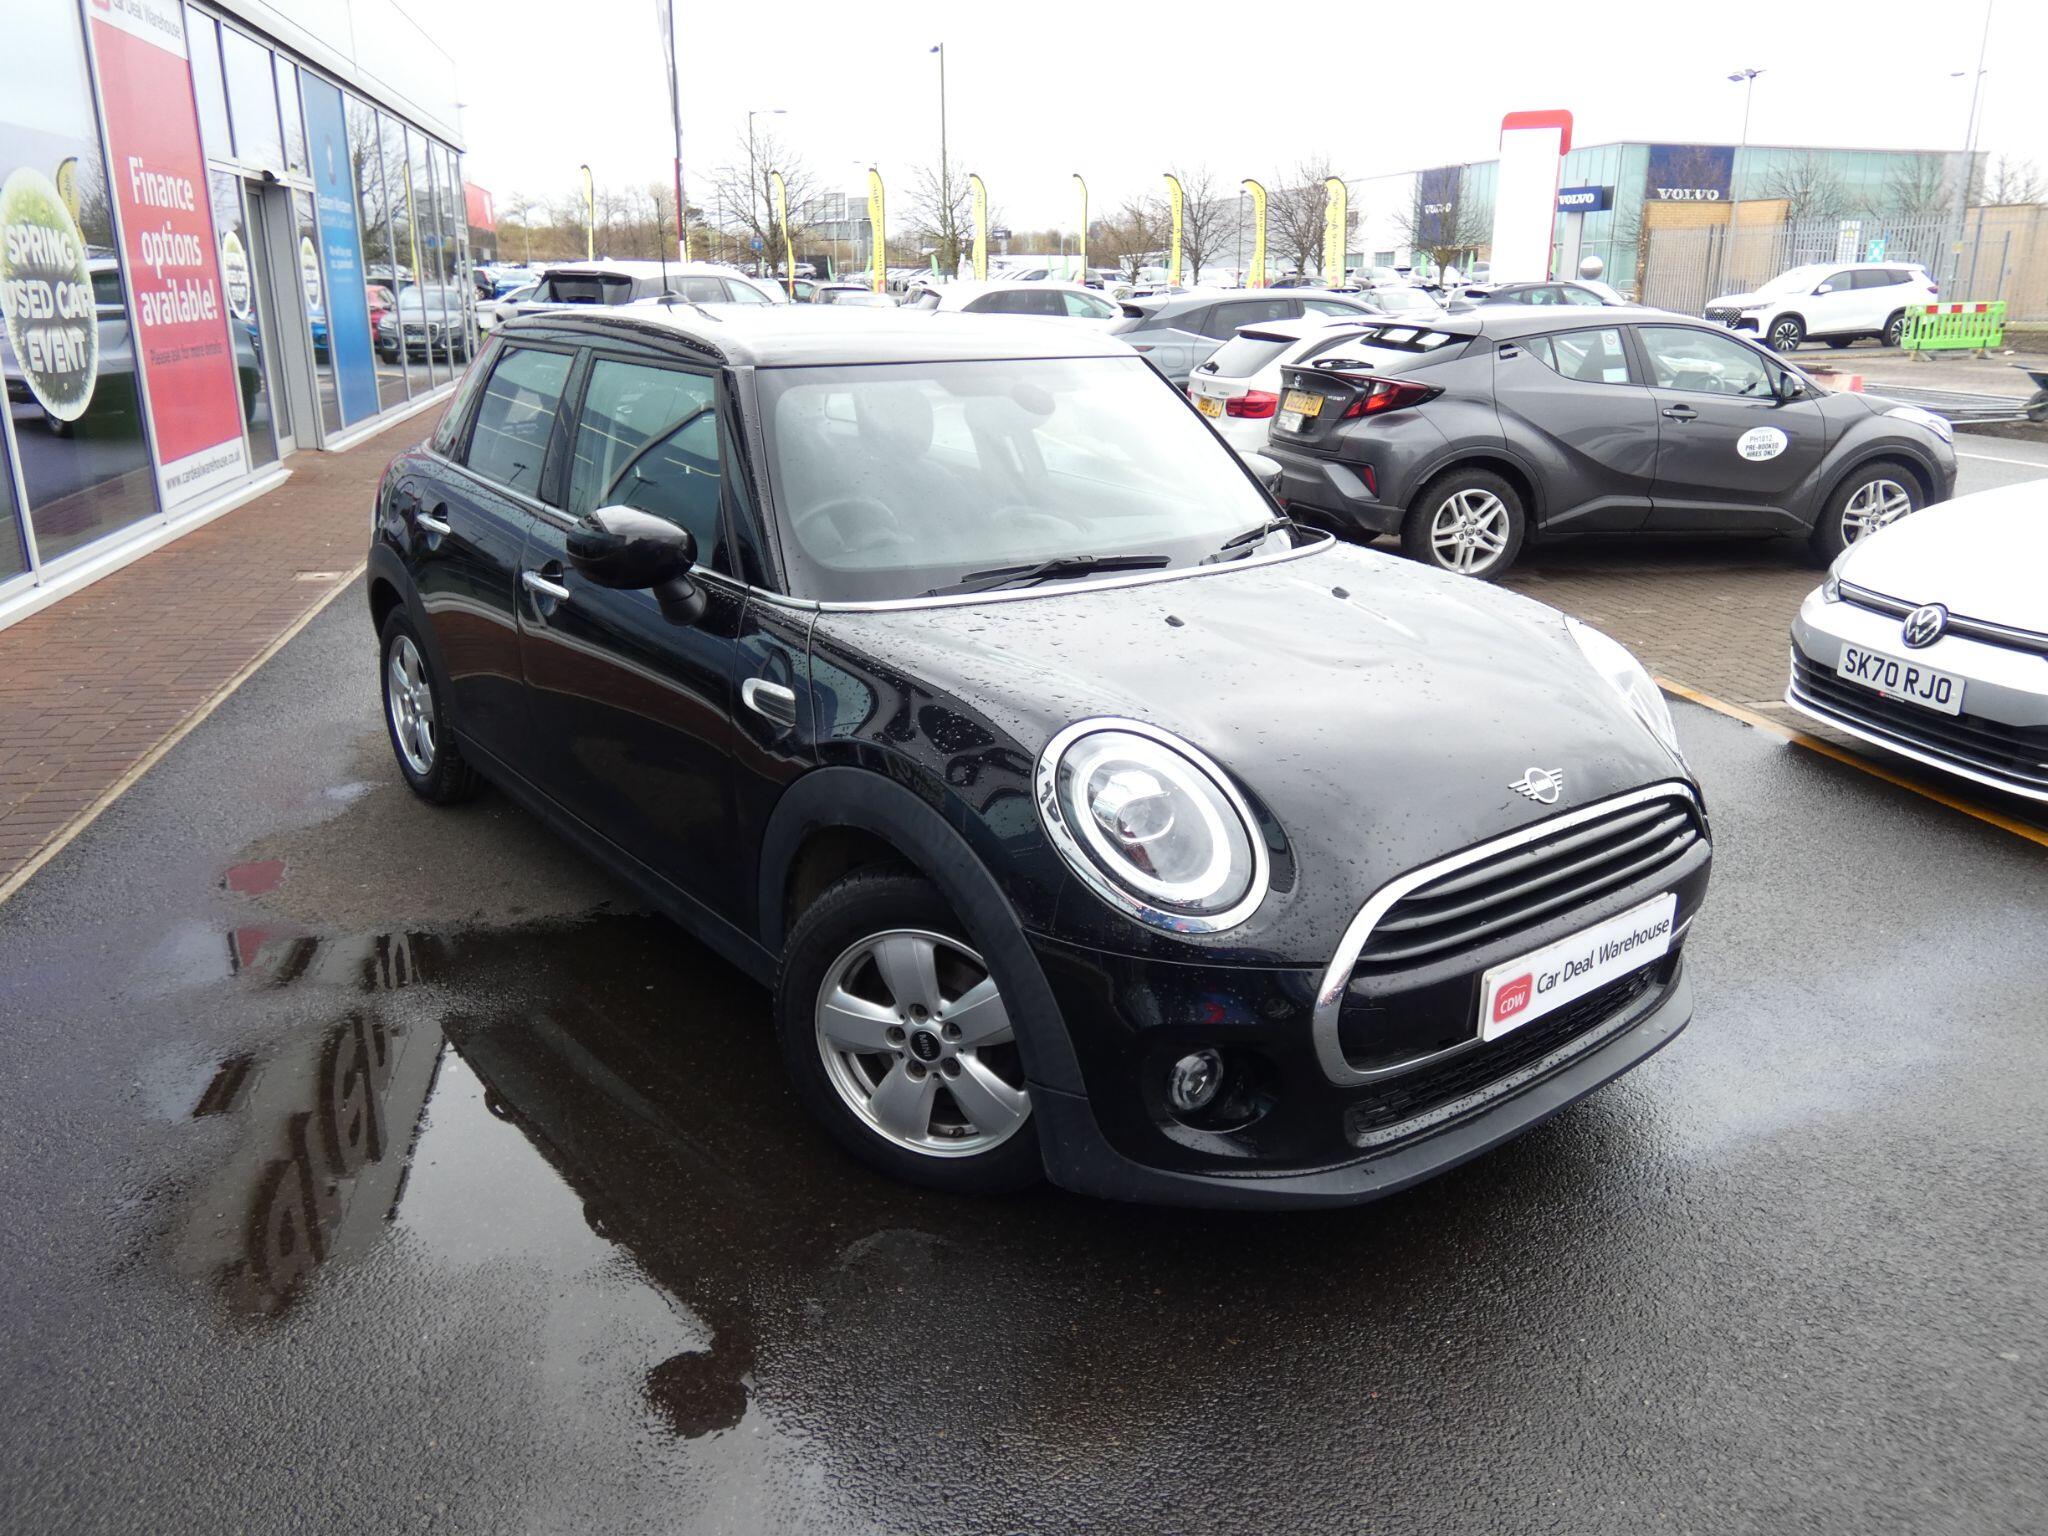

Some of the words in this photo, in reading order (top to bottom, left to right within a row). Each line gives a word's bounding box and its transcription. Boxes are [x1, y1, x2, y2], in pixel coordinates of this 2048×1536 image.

[143, 4, 181, 39] Warehouse
[128, 156, 195, 211] Finance
[1559, 193, 1595, 205] VOLVO
[1657, 188, 1719, 201] VOLVO
[6, 224, 75, 272] SPRING
[141, 220, 202, 279] options
[4, 279, 54, 319] USED
[55, 281, 93, 320] CAR
[140, 278, 218, 327] available!
[26, 325, 87, 373] EVENT
[1745, 442, 1779, 452] PRE-BOOKED
[1763, 449, 1777, 457] ONLY
[1845, 648, 1899, 688] SK70
[1903, 667, 1952, 704] RJO
[1537, 969, 1560, 994] Car
[1563, 950, 1594, 982] Deal
[1599, 918, 1670, 964] Warehouse
[1500, 991, 1526, 1014] CDW
